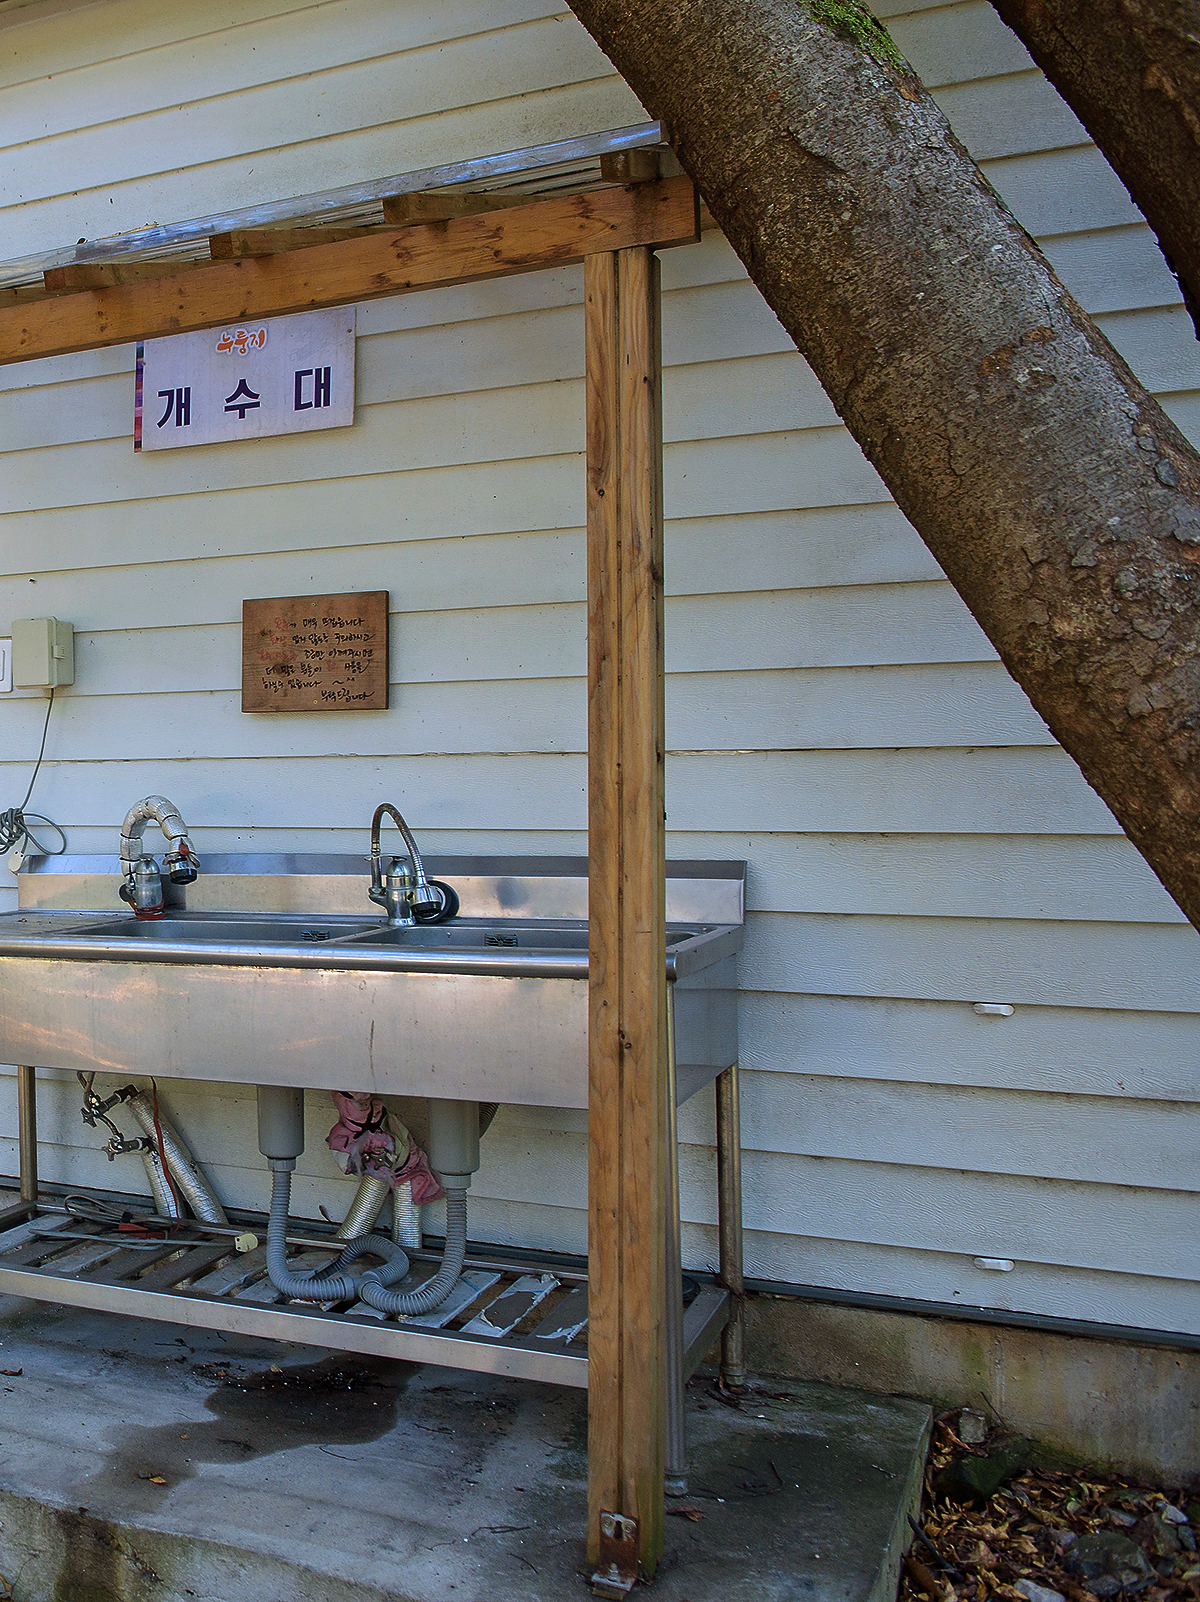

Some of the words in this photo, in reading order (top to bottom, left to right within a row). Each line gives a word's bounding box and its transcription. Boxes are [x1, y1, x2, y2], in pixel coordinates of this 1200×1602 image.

[216, 328, 266, 355] 누룽지
[302, 618, 318, 630] 매우
[322, 616, 366, 628] 뜨겁습니다
[304, 648, 325, 661] 조금만
